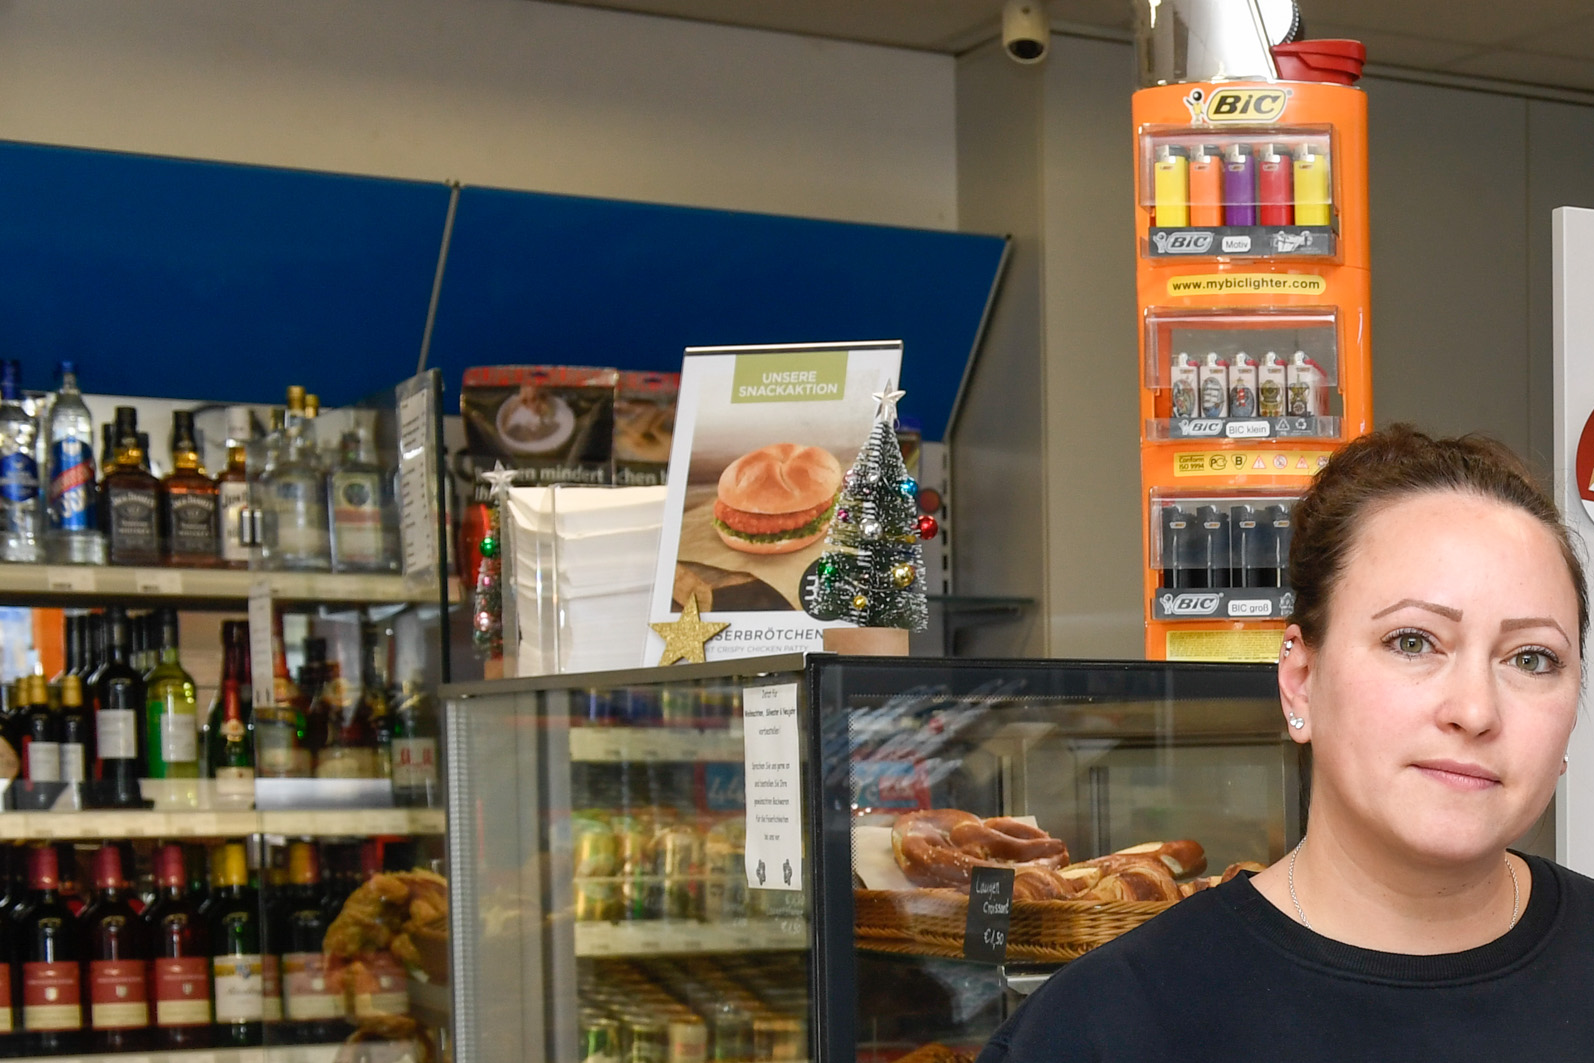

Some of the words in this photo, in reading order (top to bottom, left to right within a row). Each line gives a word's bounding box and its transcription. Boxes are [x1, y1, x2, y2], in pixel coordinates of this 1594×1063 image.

[1225, 240, 1249, 248] Motiv
[1172, 278, 1320, 291] www.mybiclighter.com
[762, 371, 817, 384] UNSERE
[738, 384, 838, 397] SNACKAKTION
[1247, 425, 1267, 433] klein
[1231, 604, 1247, 612] BIC
[1249, 604, 1269, 615] groß
[976, 873, 1000, 895] Laugen
